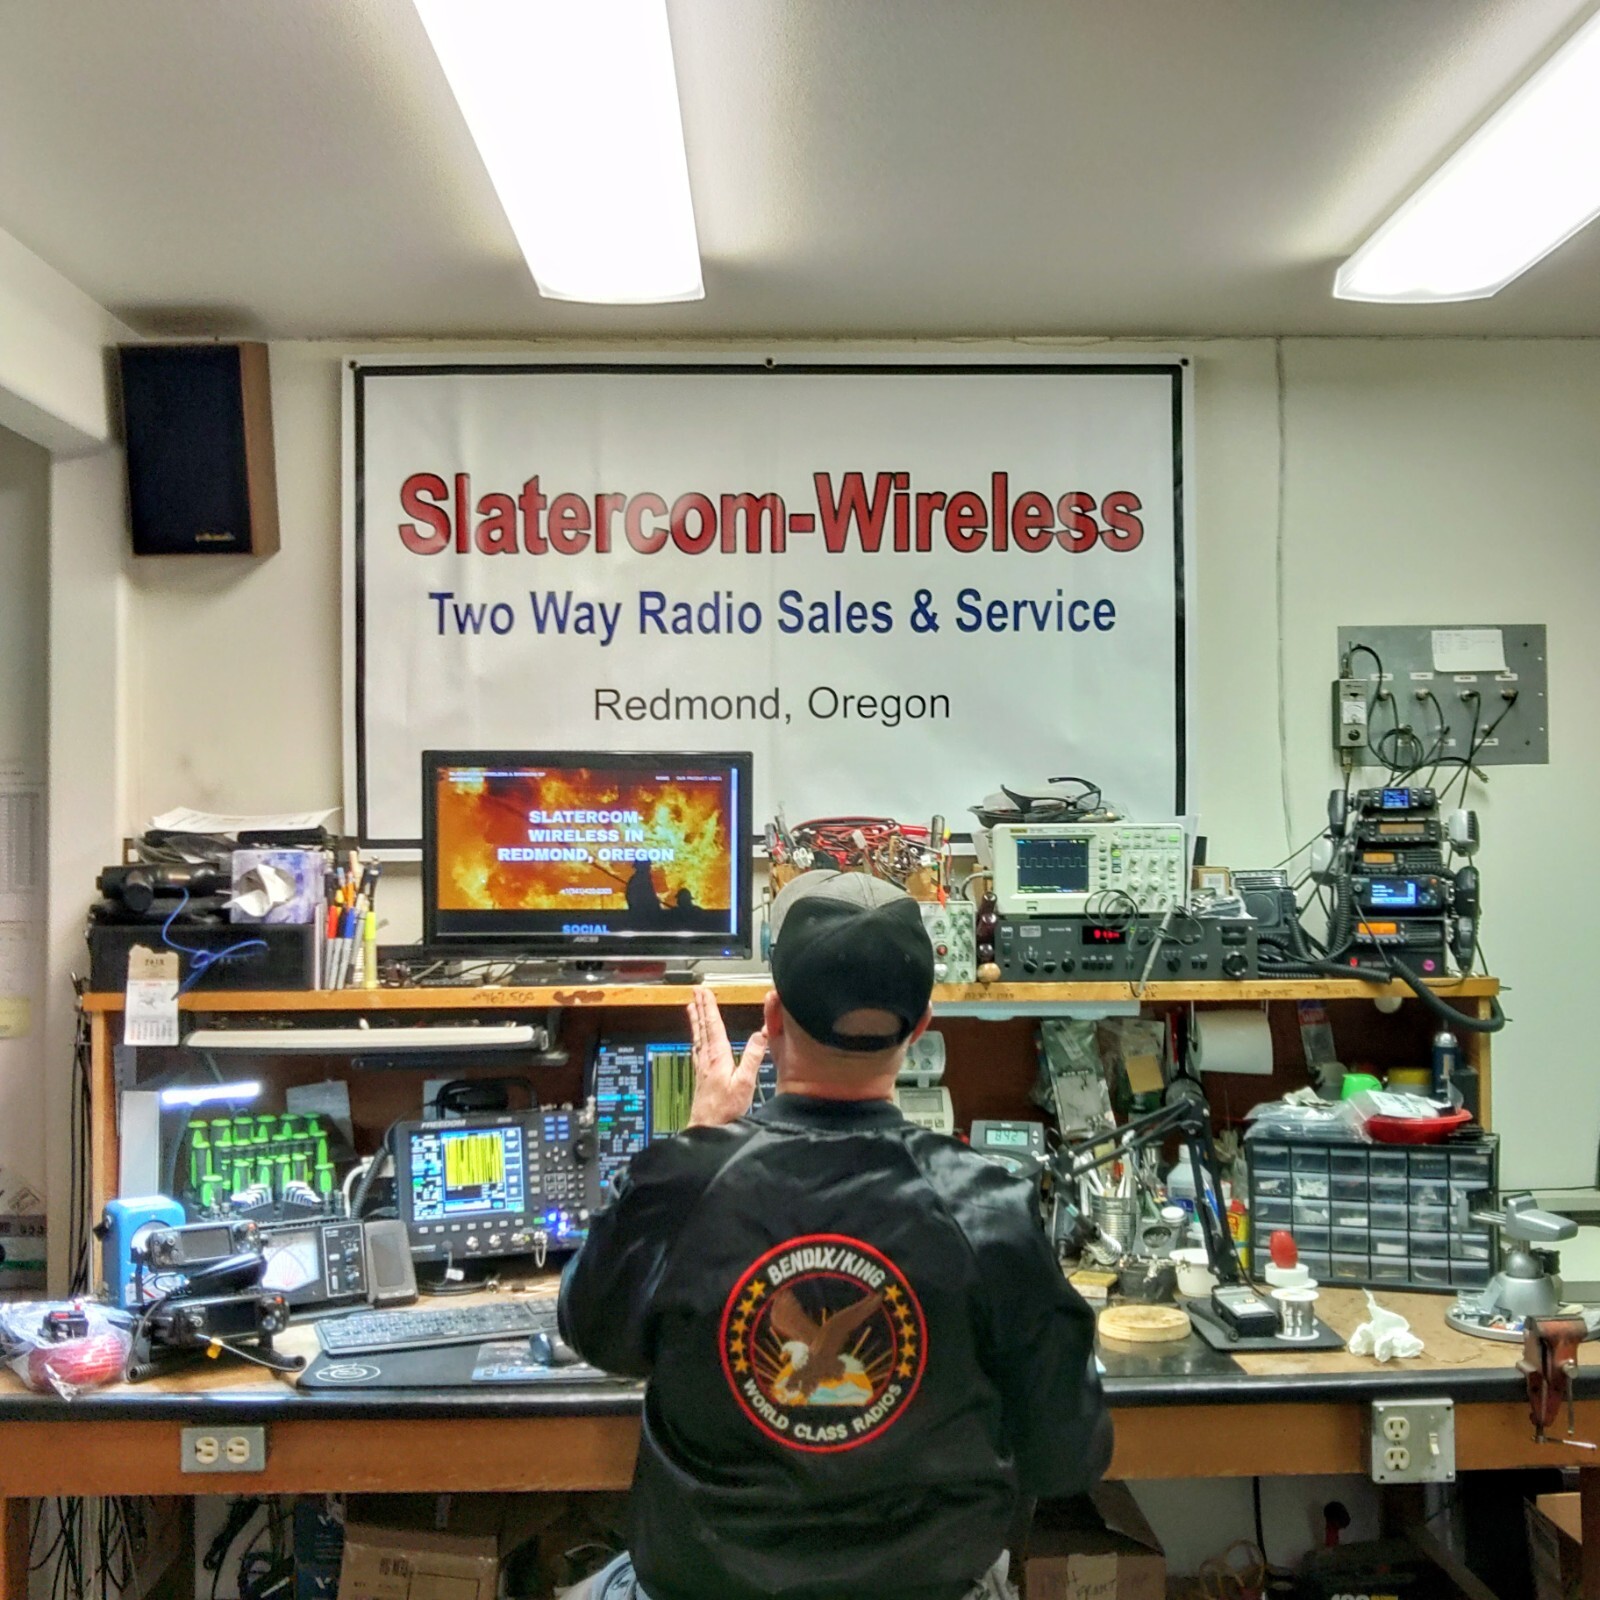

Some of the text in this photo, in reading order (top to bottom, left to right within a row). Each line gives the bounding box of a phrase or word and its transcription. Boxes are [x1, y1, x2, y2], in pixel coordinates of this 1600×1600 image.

[398, 472, 1144, 555] Slatercom-Wireless
[429, 588, 1116, 645] Two Way Radio Sales & Service
[595, 686, 950, 728] Redmond, Oregon
[528, 829, 644, 842] WIRELESS IN
[529, 810, 644, 824] SLATERCOM-
[497, 848, 674, 863] REDMOND, OREGON
[562, 924, 610, 935] SOCIAL
[767, 1247, 887, 1288] BENDIX/KING
[744, 1378, 902, 1442] WORLD CLASS RADIOS
